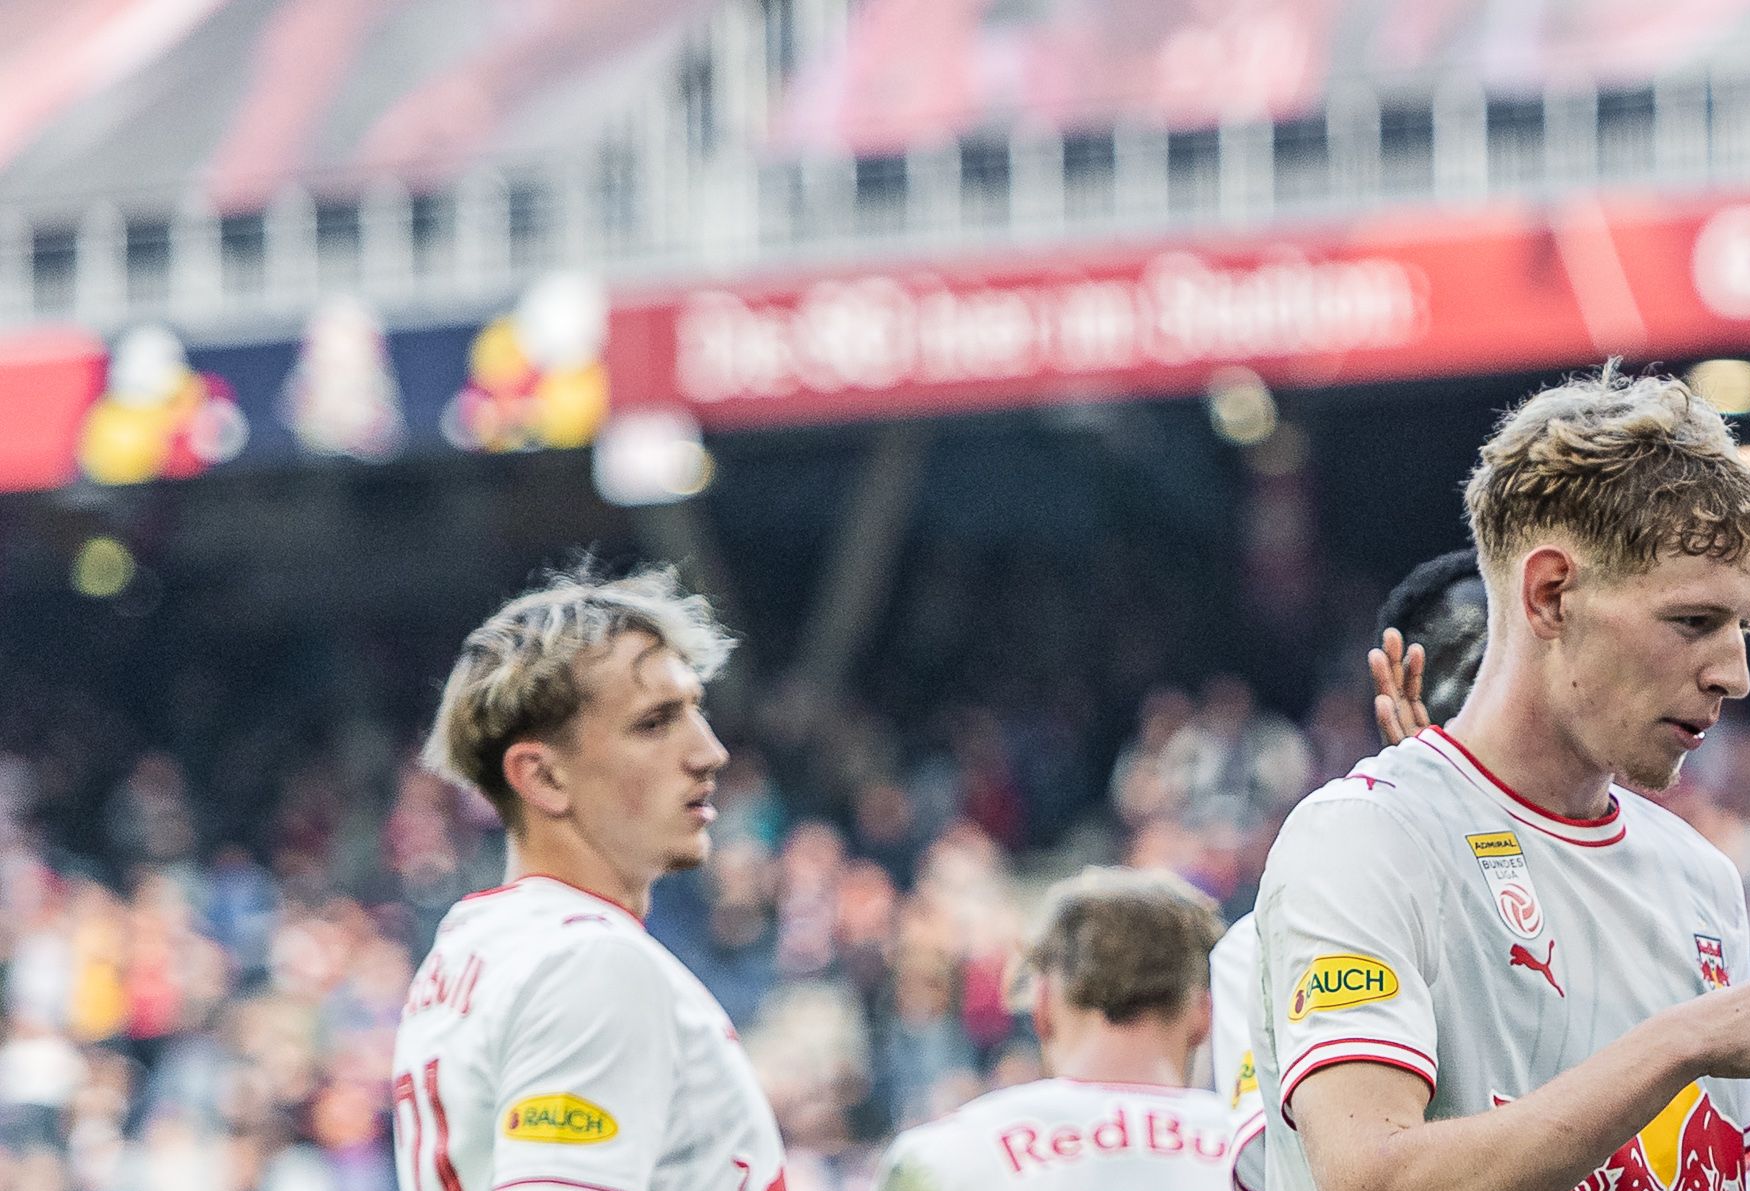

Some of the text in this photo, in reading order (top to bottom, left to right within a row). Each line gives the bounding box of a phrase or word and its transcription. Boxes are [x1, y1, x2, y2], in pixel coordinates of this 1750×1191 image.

[1475, 839, 1517, 850] ADMIRAL
[1482, 858, 1523, 869] BUNDES
[523, 1108, 603, 1134] RAUCH
[1000, 1108, 1129, 1171] Red
